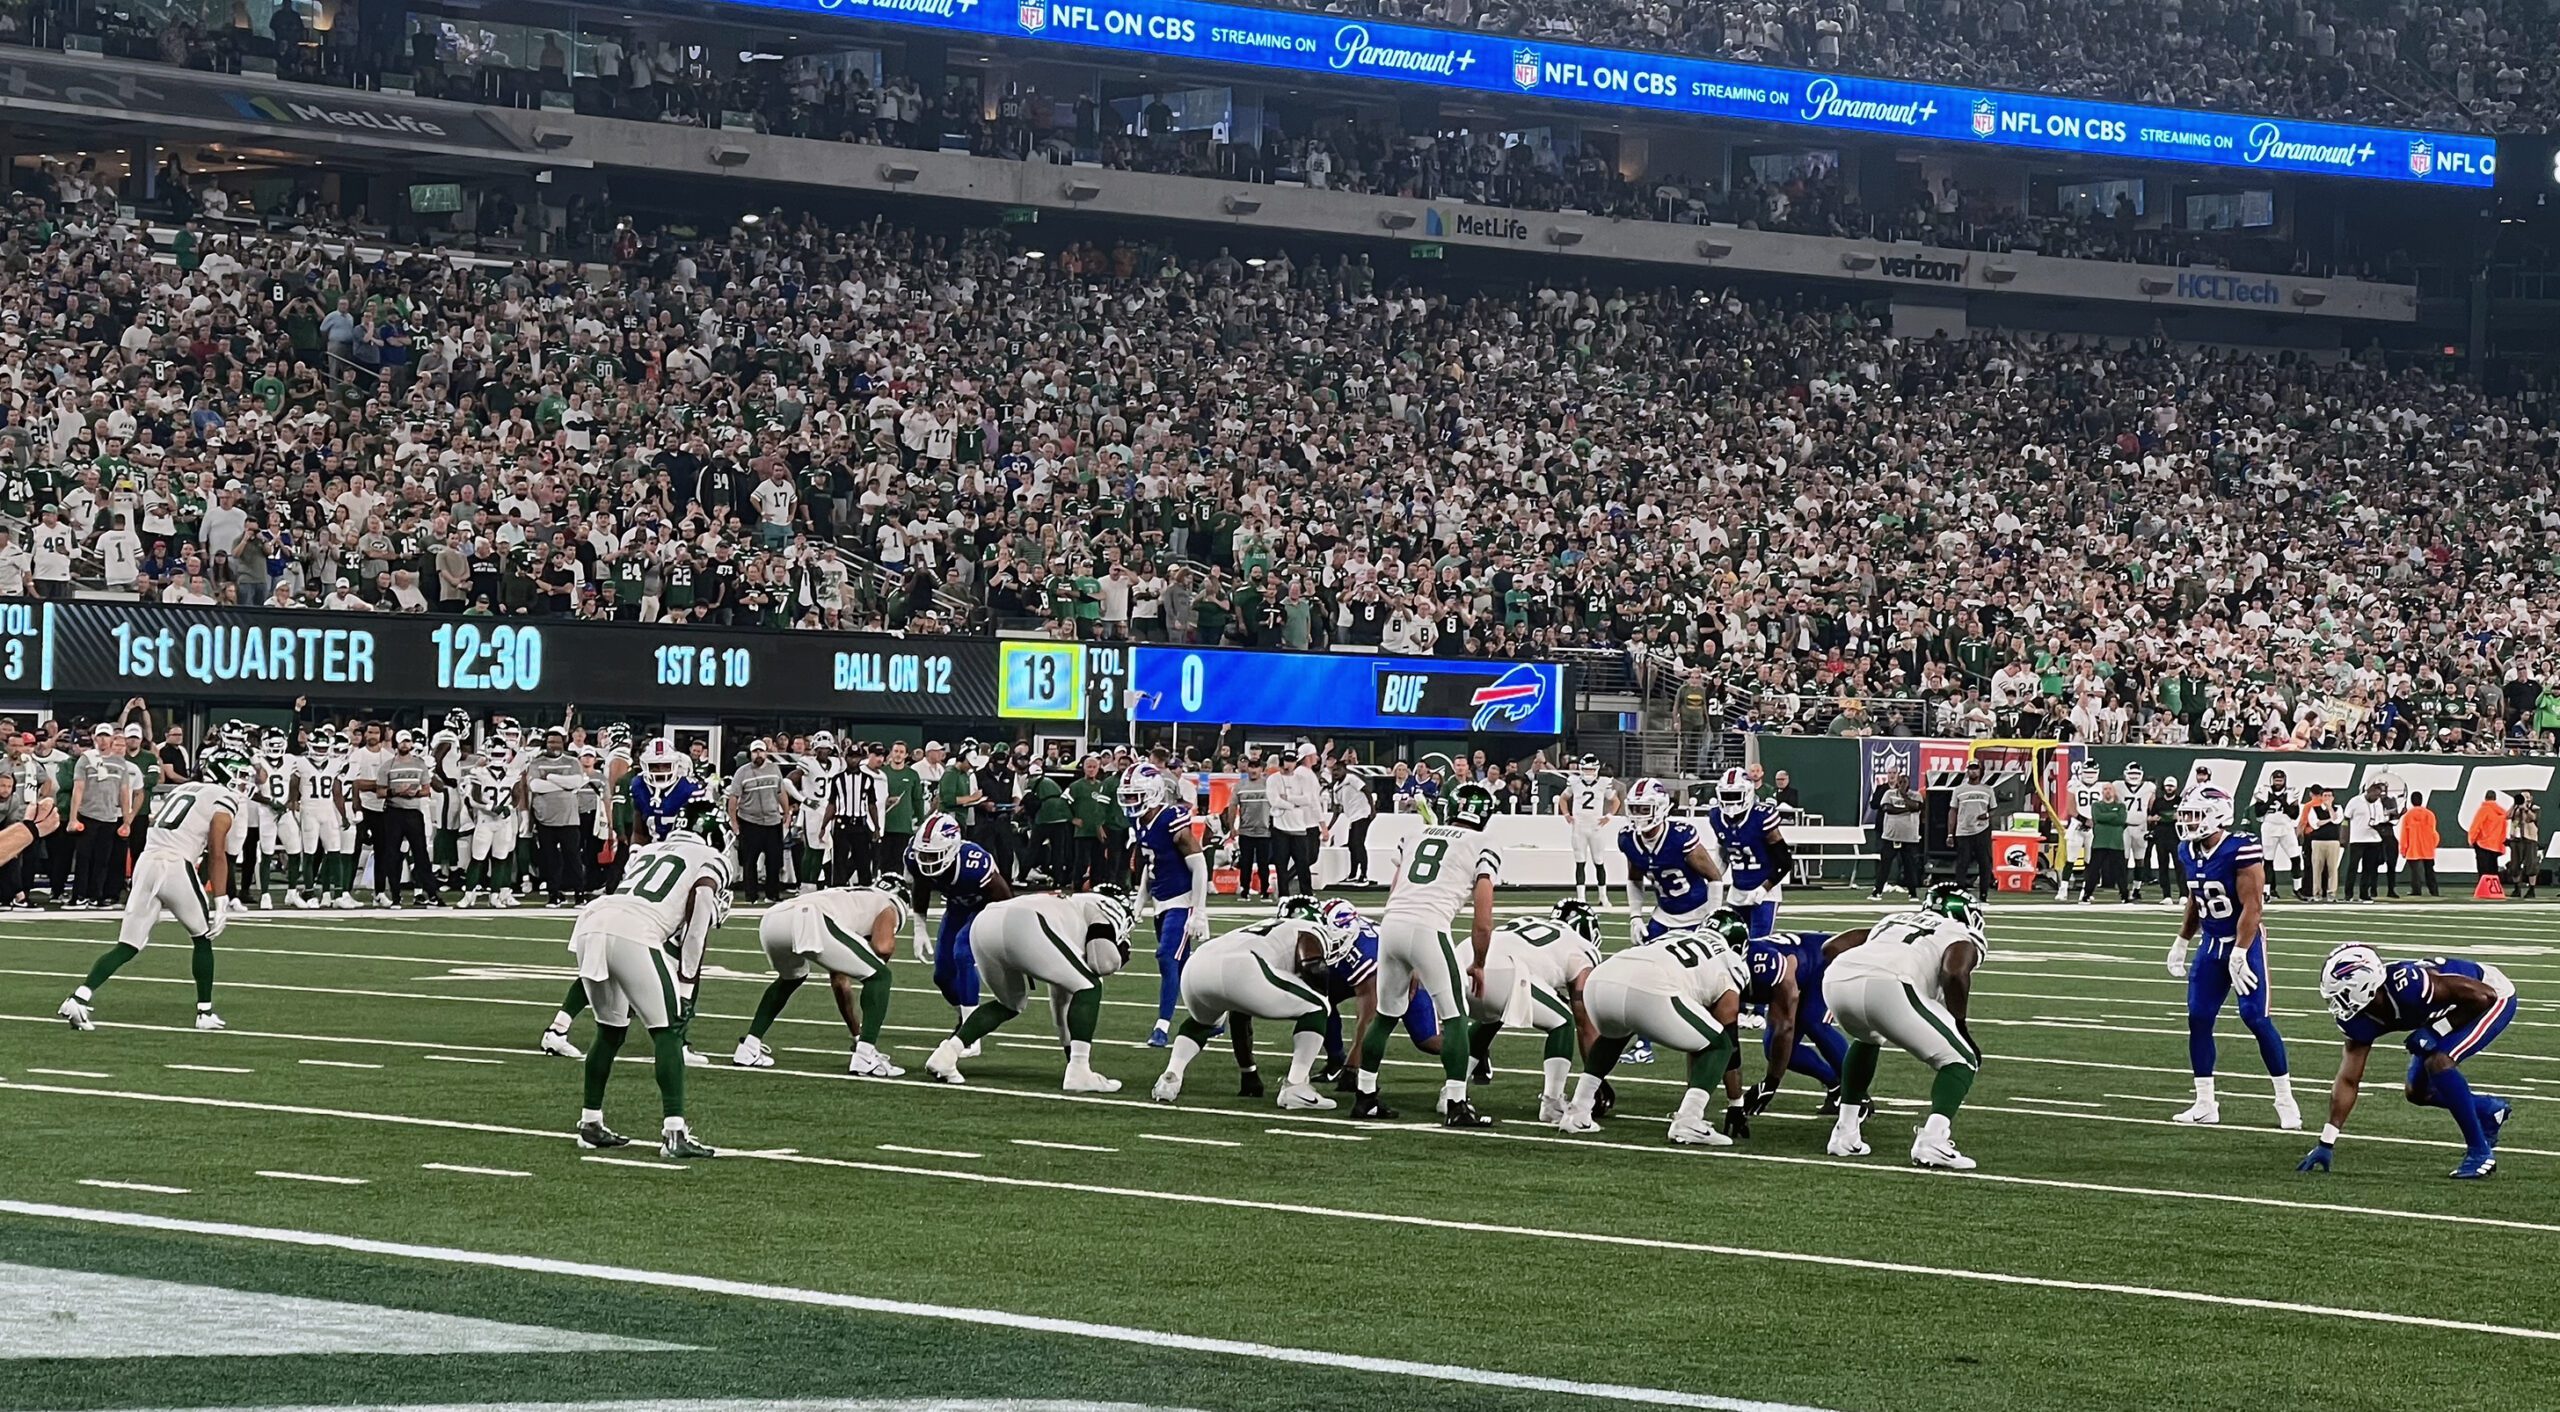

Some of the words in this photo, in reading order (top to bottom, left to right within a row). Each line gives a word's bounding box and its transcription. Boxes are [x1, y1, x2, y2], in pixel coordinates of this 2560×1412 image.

[1053, 5, 1099, 31] NFL
[1104, 10, 1142, 35] ON
[1148, 18, 1196, 42] CBS
[1211, 27, 1292, 49] STREAMING
[1295, 38, 1316, 52] ON
[1329, 25, 1476, 75] Paramount+
[1545, 62, 1588, 86] NFL
[1593, 68, 1629, 91] ON
[1633, 71, 1677, 96] CBS
[1691, 82, 1766, 102] STREAMING
[1769, 91, 1789, 105] ON
[1801, 78, 1938, 125] Paramount+
[287, 102, 447, 136] MetLife
[2001, 110, 2042, 134] NFL
[2046, 115, 2080, 138] ON
[2084, 120, 2127, 142] CBS
[2140, 129, 2211, 147] STREAMING
[2214, 135, 2233, 149] ON
[2243, 122, 2375, 166] Paramount+
[2437, 151, 2475, 173] NFL
[1456, 214, 1528, 240] MetLife
[1880, 254, 1962, 282] verizon
[273, 286, 284, 301] 8
[2177, 273, 2280, 305] HCLTech
[147, 308, 166, 327] 56
[623, 316, 638, 329] 95
[412, 336, 429, 350] 73
[813, 343, 821, 356] 8
[1011, 342, 1020, 355] 8
[155, 363, 165, 381] 8
[596, 363, 612, 378] 80
[933, 429, 949, 443] 17
[713, 472, 730, 490] 94
[81, 500, 93, 518] 7
[773, 491, 788, 508] 17
[1202, 505, 1210, 521] 8
[401, 538, 418, 554] 15
[892, 531, 898, 548] 1
[115, 541, 125, 563] 1
[621, 563, 642, 582] 24
[672, 568, 692, 586] 22
[1040, 594, 1049, 609] 8
[1589, 597, 1607, 612] 24
[1672, 600, 1687, 615] 19
[1364, 605, 1374, 621] 8
[1392, 619, 1402, 632] 8
[1446, 617, 1456, 633] 8
[3, 638, 24, 682] 3
[111, 621, 174, 678] 1st
[184, 623, 375, 684] QUARTER
[431, 623, 542, 692] 12:30
[1089, 647, 1124, 677] TOL
[654, 645, 696, 686] 1ST
[699, 647, 717, 687] &
[722, 648, 750, 688] 10
[834, 652, 886, 693] BALL
[888, 655, 919, 694] ON
[924, 656, 952, 695] 12
[1024, 654, 1056, 701] 13
[1181, 654, 1204, 713] 0
[1383, 675, 1428, 713] BUF
[1098, 684, 1114, 714] 3
[270, 774, 284, 798] 6
[309, 777, 333, 799] 18
[483, 786, 512, 807] 32
[1582, 791, 1595, 810] 2
[2077, 791, 2100, 808] 66
[2124, 797, 2143, 812] 71
[675, 817, 688, 828] 20
[1423, 827, 1466, 839] RODGERS
[966, 850, 983, 869] 56
[1408, 838, 1448, 885] 8
[1729, 846, 1761, 871] 21
[614, 854, 687, 902] 20
[2007, 874, 2021, 889] G
[2187, 881, 2233, 919] 58
[1346, 946, 1363, 969] 91
[1753, 952, 1768, 974] 92
[2392, 968, 2409, 992] 50
